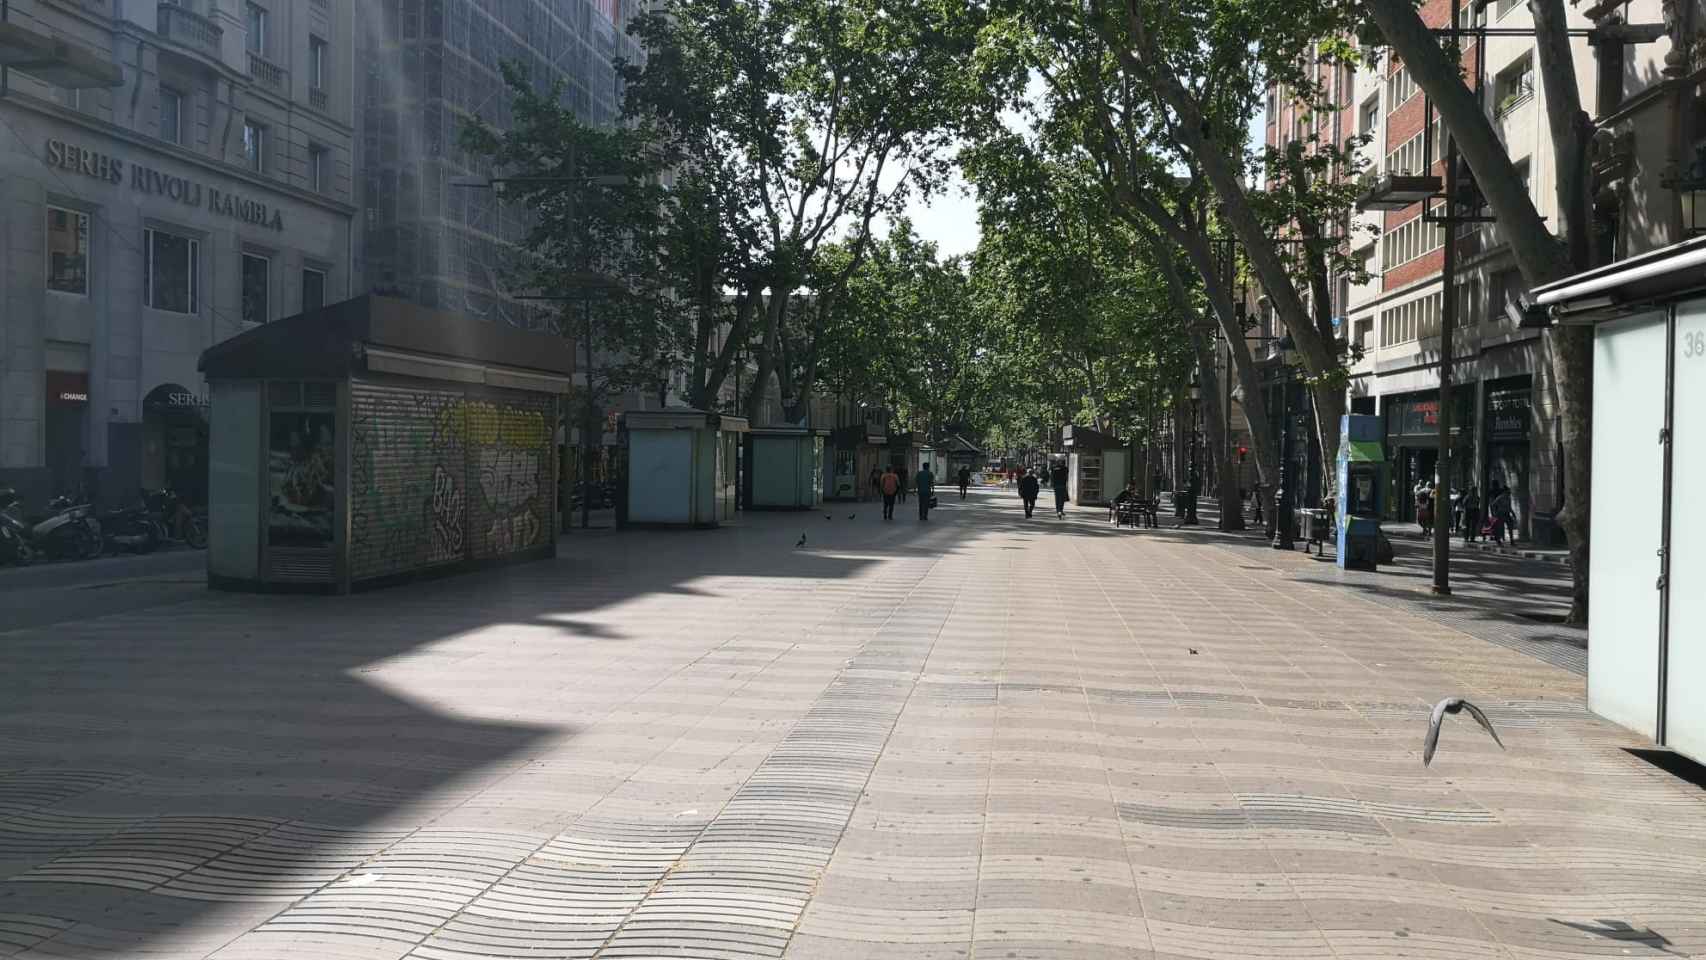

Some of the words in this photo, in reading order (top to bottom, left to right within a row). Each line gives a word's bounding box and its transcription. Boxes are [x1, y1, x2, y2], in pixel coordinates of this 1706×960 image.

[48, 138, 122, 185] SERHS
[131, 163, 201, 208] RIVOLI
[208, 187, 283, 232] RAMBLA
[1684, 330, 1705, 358] 36
